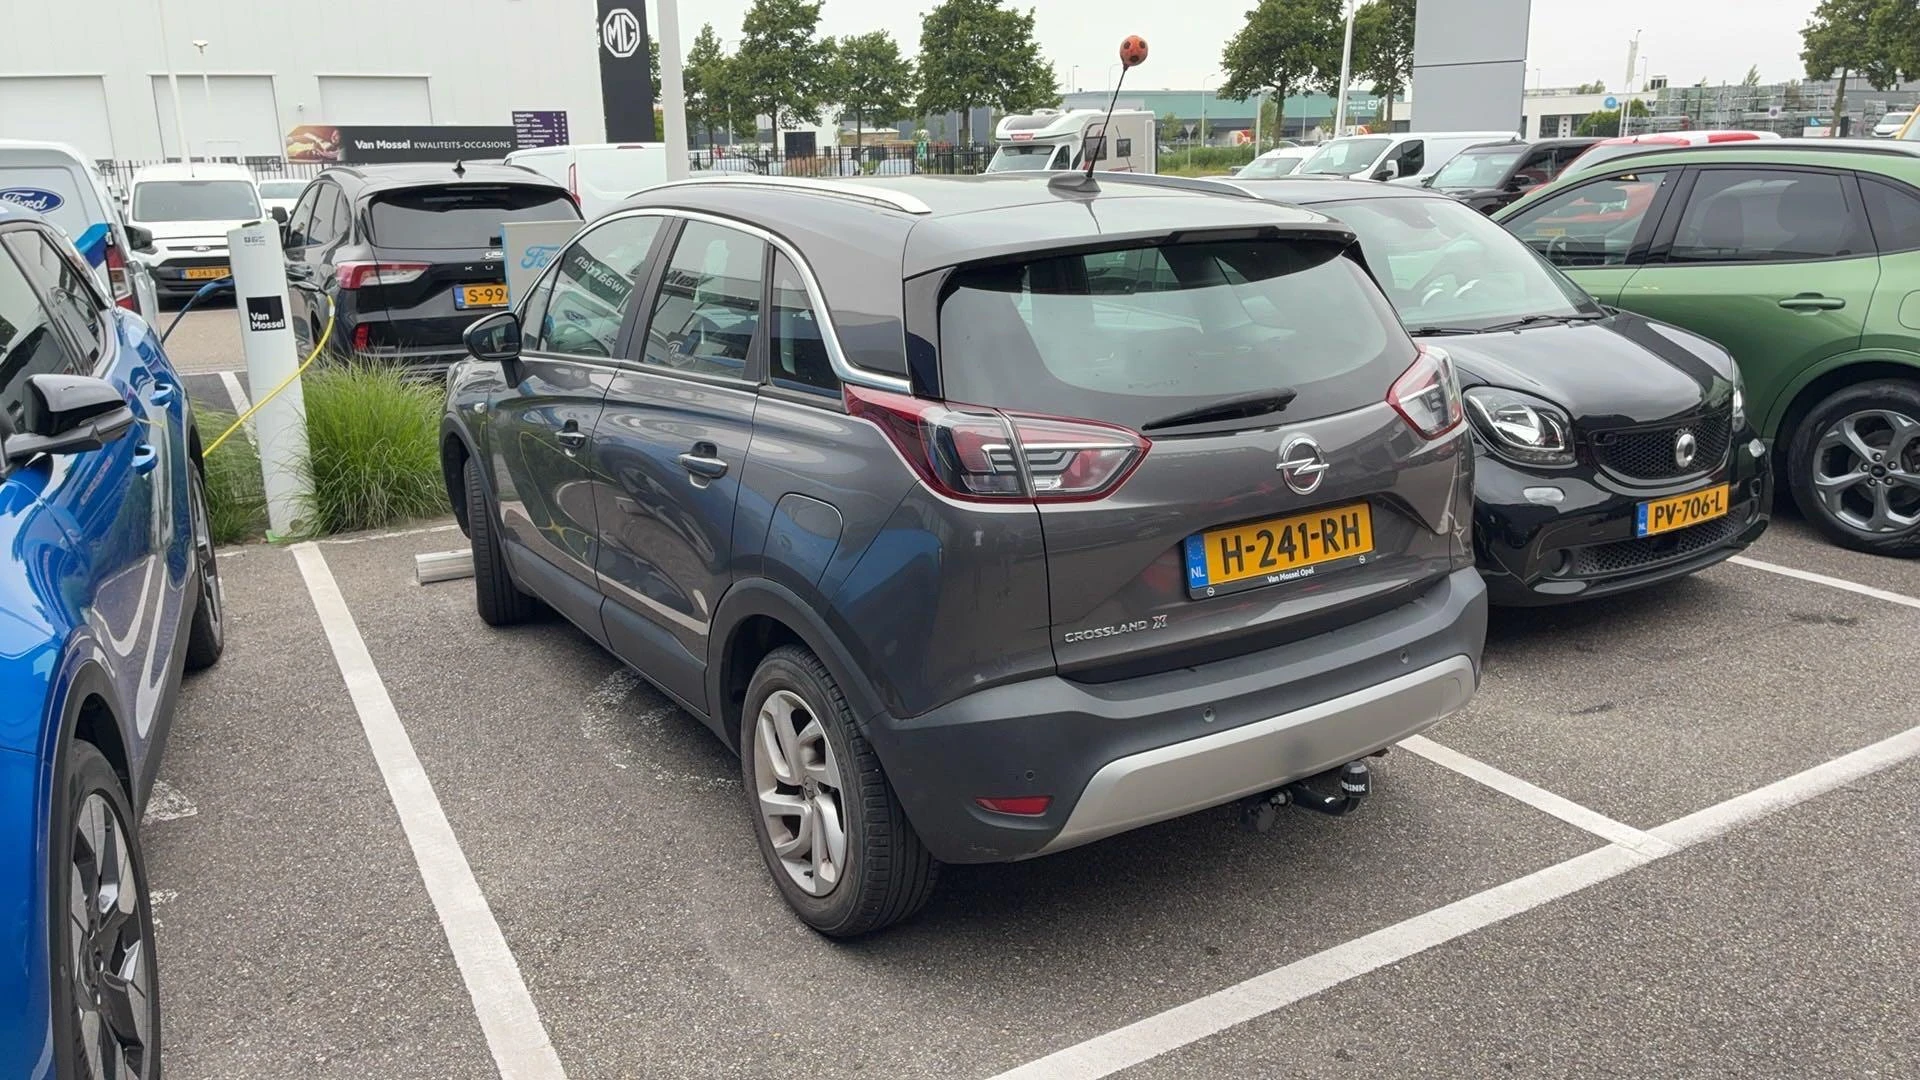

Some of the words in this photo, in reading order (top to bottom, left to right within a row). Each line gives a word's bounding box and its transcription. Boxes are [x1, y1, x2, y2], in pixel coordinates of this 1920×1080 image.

[605, 11, 638, 55] MG
[355, 140, 375, 149] Van
[377, 139, 411, 149] Mossel
[414, 141, 511, 149] KWALITEITS-OCCASIONS
[250, 312, 269, 321] Van
[251, 320, 284, 330] Mossel
[1654, 491, 1723, 529] PV-706-L
[1221, 512, 1361, 575] H-241-RH
[1191, 565, 1206, 579] NL
[1267, 573, 1280, 583] Van
[1279, 570, 1301, 582] Mossel
[1300, 566, 1315, 577] Opel
[1064, 620, 1148, 643] CROSSLAND
[1152, 614, 1168, 630] X
